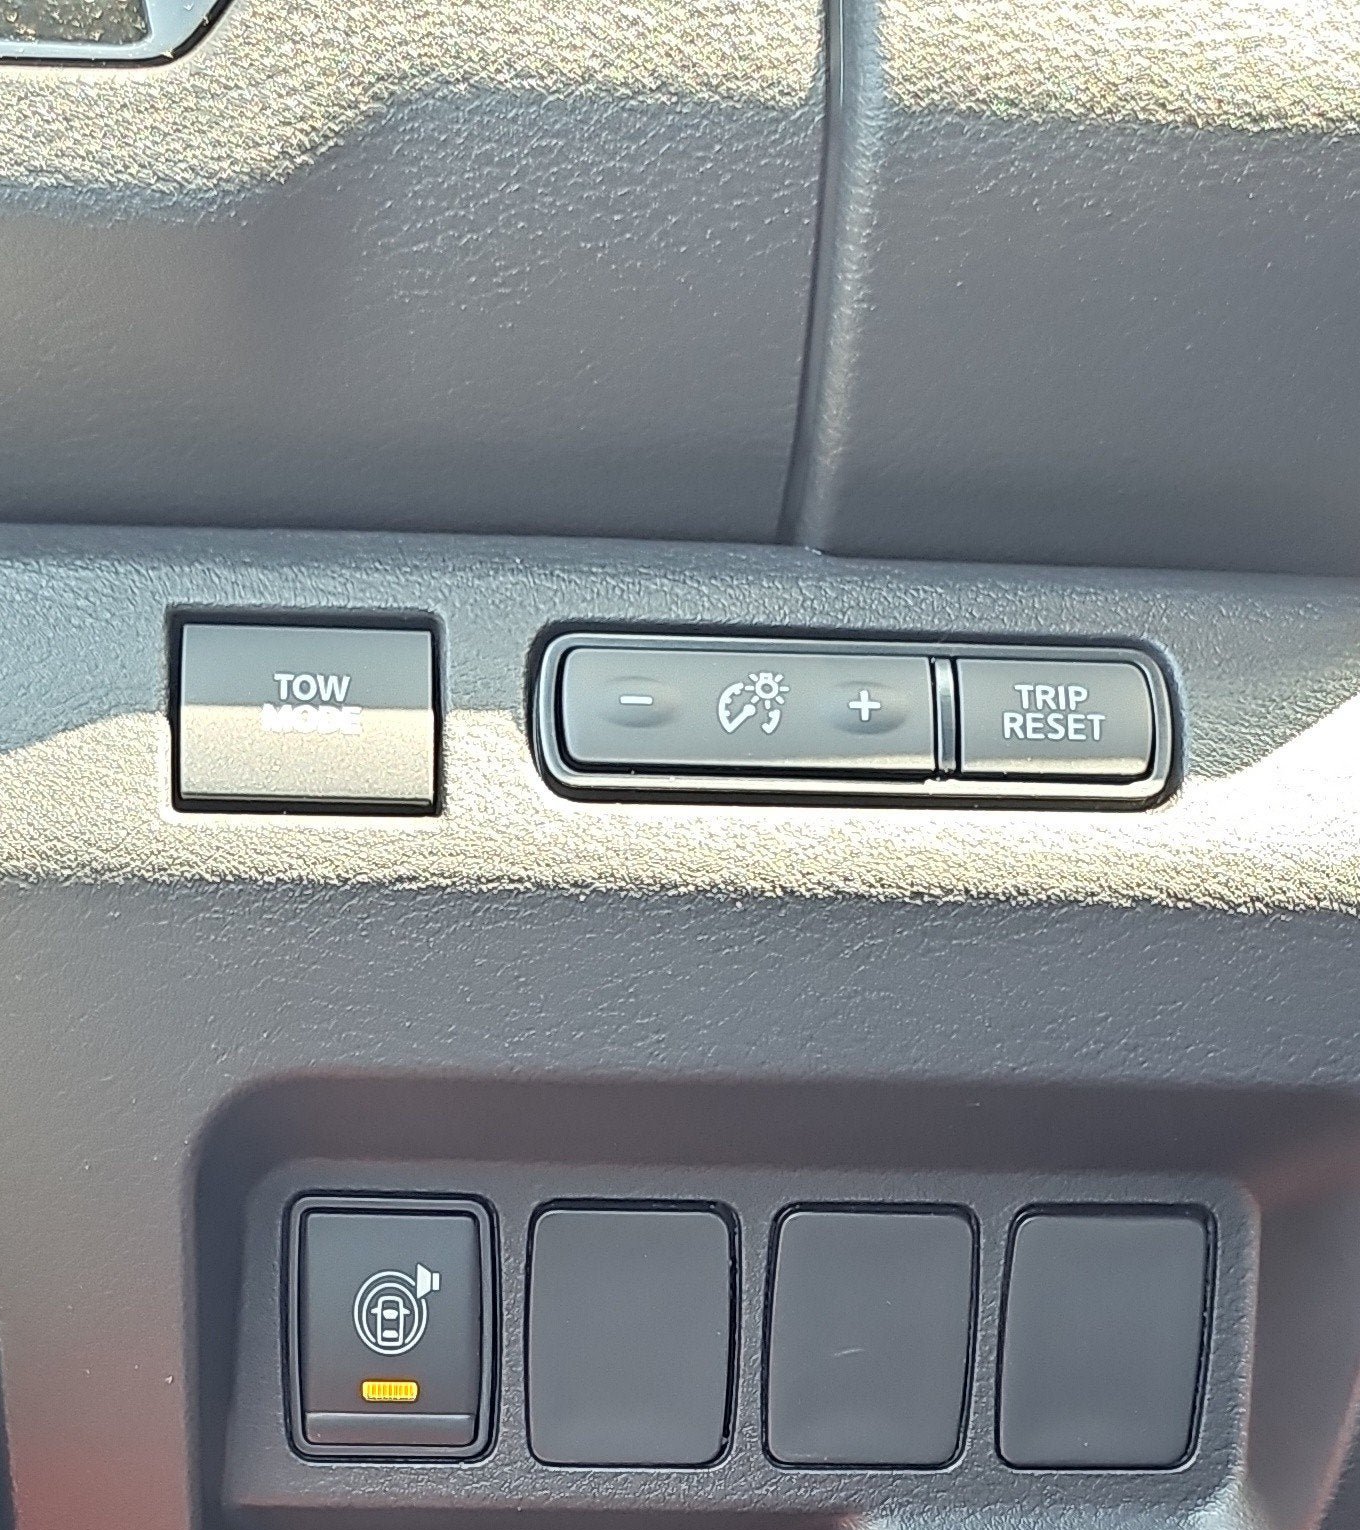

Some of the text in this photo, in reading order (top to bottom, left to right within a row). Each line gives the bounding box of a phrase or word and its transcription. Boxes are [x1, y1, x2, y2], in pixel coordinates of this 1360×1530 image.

[273, 673, 351, 702] TOW
[1014, 684, 1088, 711] TRIP
[261, 703, 362, 735] MODE
[1003, 712, 1106, 741] RESET
